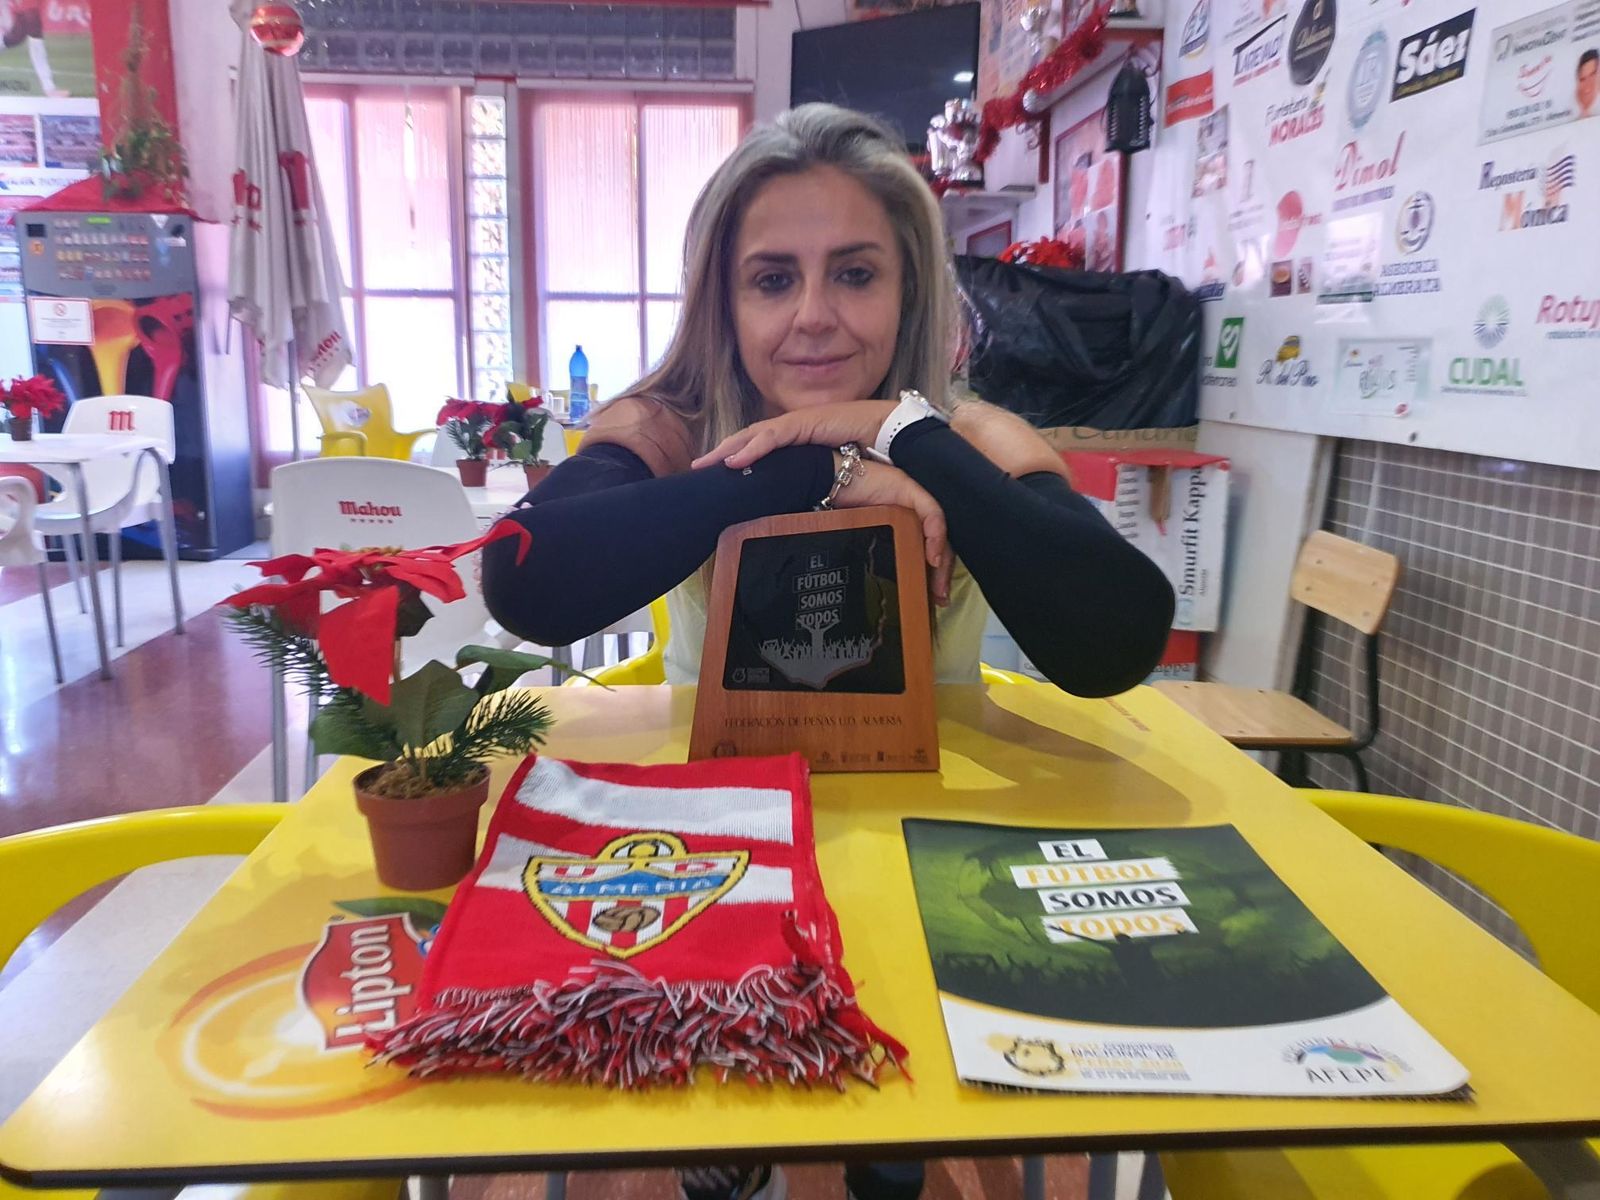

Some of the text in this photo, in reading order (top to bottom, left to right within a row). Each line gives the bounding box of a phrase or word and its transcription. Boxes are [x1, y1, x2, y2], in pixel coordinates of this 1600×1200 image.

[1449, 357, 1524, 387] CUDAL
[338, 500, 403, 517] Mahou
[809, 554, 825, 569] EL
[1178, 526, 1200, 597] Smurfit
[800, 589, 843, 609] SOMOS
[799, 609, 840, 627] TODOS
[1051, 842, 1093, 859] EL
[1048, 885, 1180, 913] SOMOS
[1055, 912, 1186, 938] TODOS
[334, 923, 412, 1039] Lipton
[1304, 1066, 1396, 1084] AFEPE
